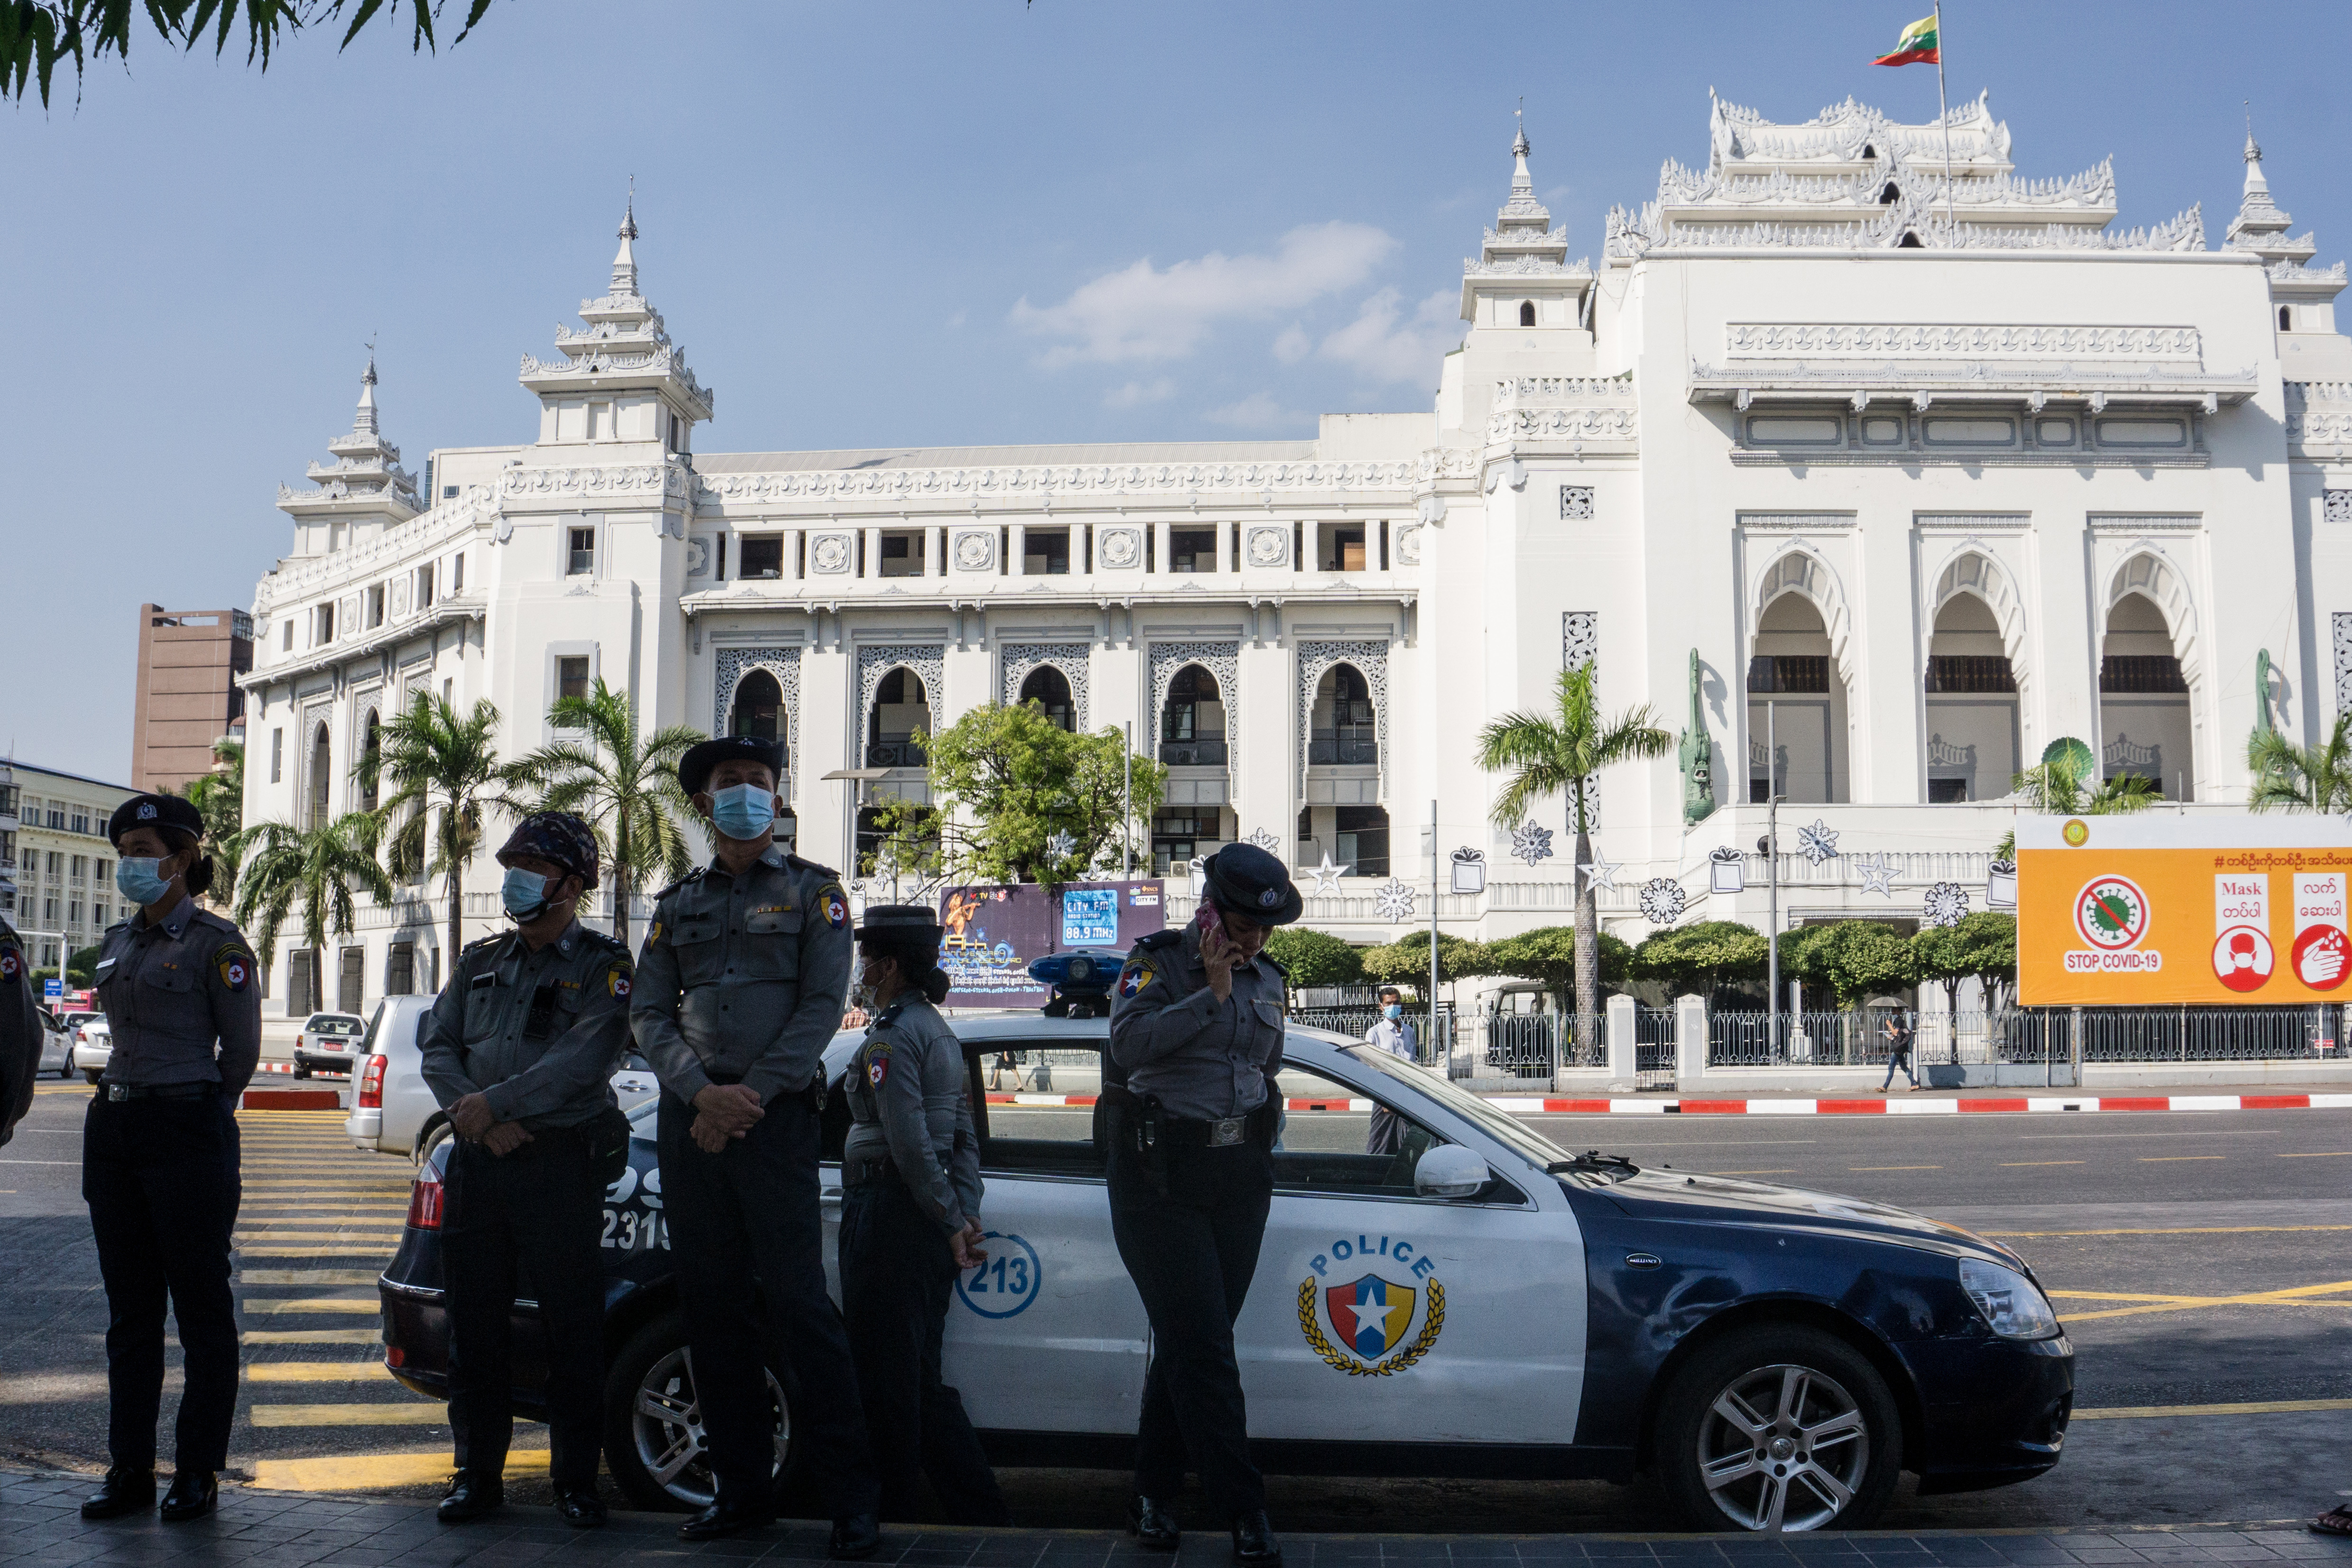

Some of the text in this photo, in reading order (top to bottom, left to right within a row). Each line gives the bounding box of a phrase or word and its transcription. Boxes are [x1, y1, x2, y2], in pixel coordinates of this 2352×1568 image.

[2222, 882, 2262, 895] Mask
[2304, 878, 2337, 894] လက်
[1067, 901, 1108, 912] CITY FM
[2223, 902, 2260, 918] တပ်ပါ
[2300, 900, 2342, 916] ဆေးပါ
[1066, 927, 1113, 939] 88.9 MHz
[2067, 954, 2158, 968] STOP COVID-19
[1309, 1235, 1436, 1281] POLICE
[968, 1256, 1028, 1294] 213
